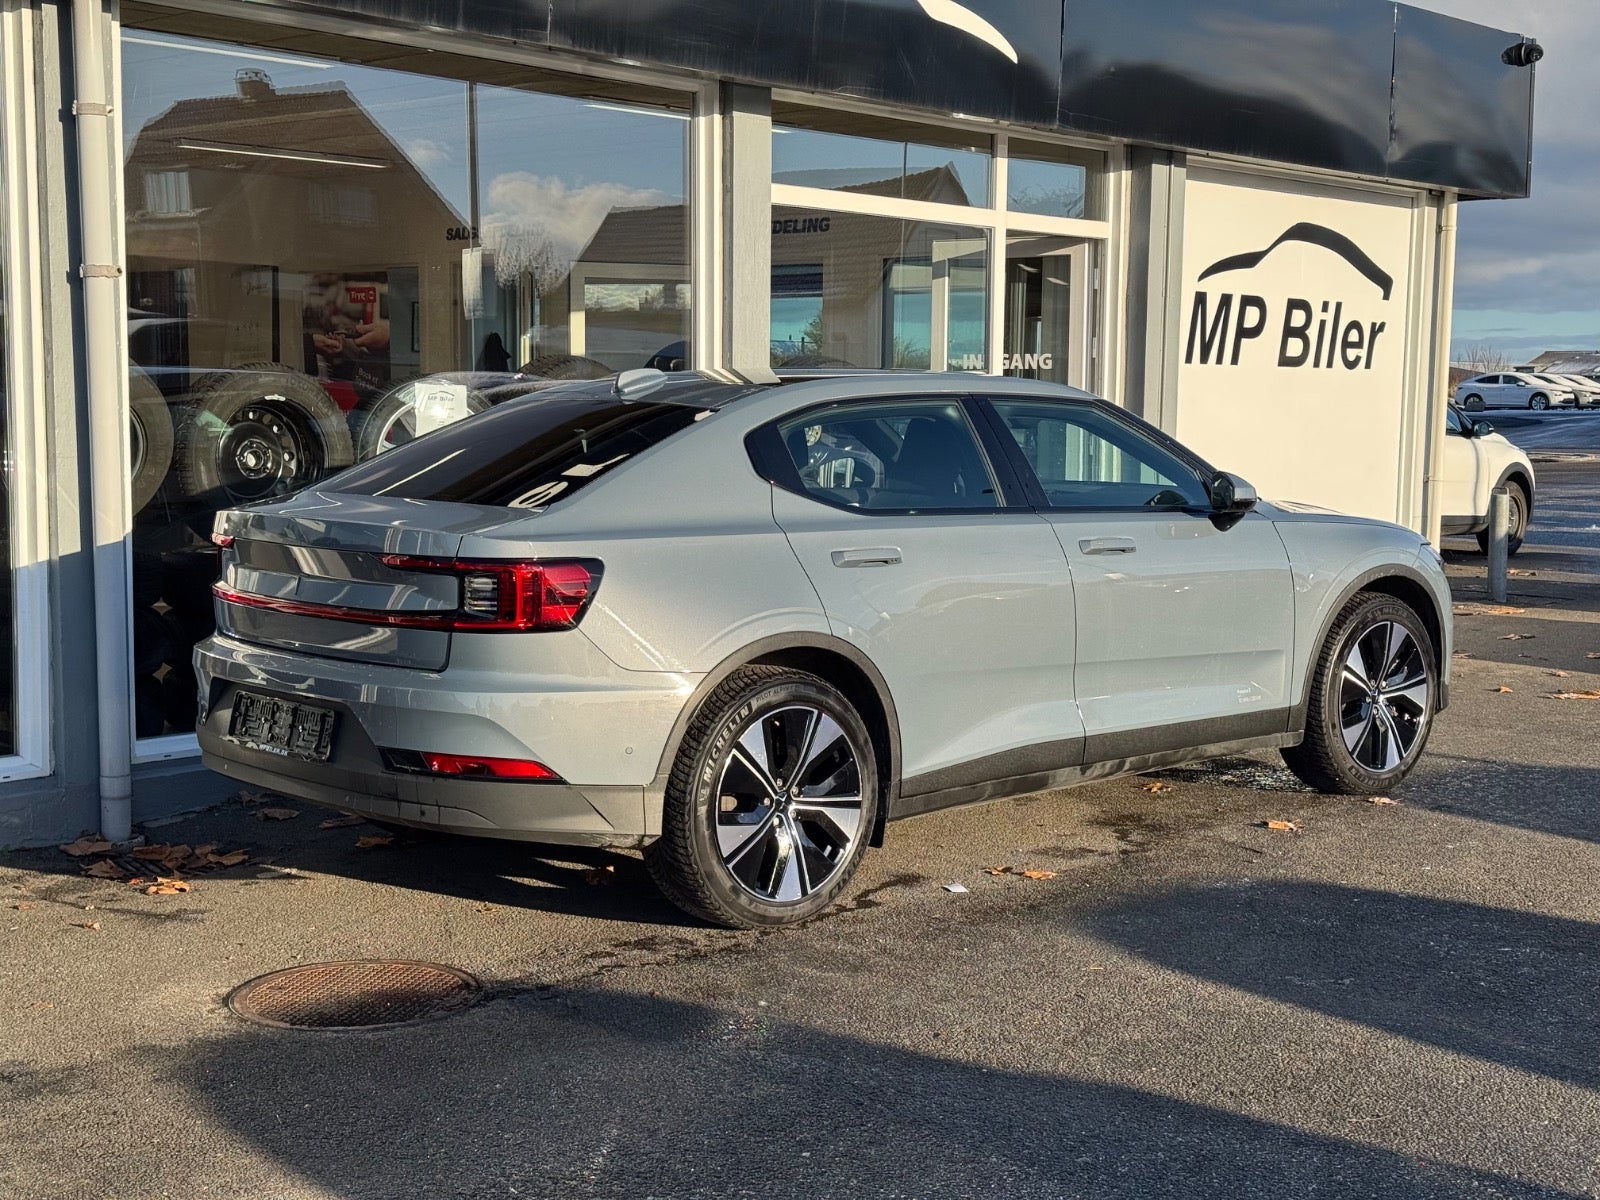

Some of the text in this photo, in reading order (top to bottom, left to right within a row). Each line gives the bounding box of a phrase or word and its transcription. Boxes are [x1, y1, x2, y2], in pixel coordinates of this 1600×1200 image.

[1185, 291, 1386, 370] MP Biler
[703, 705, 751, 784] MICHELIN
